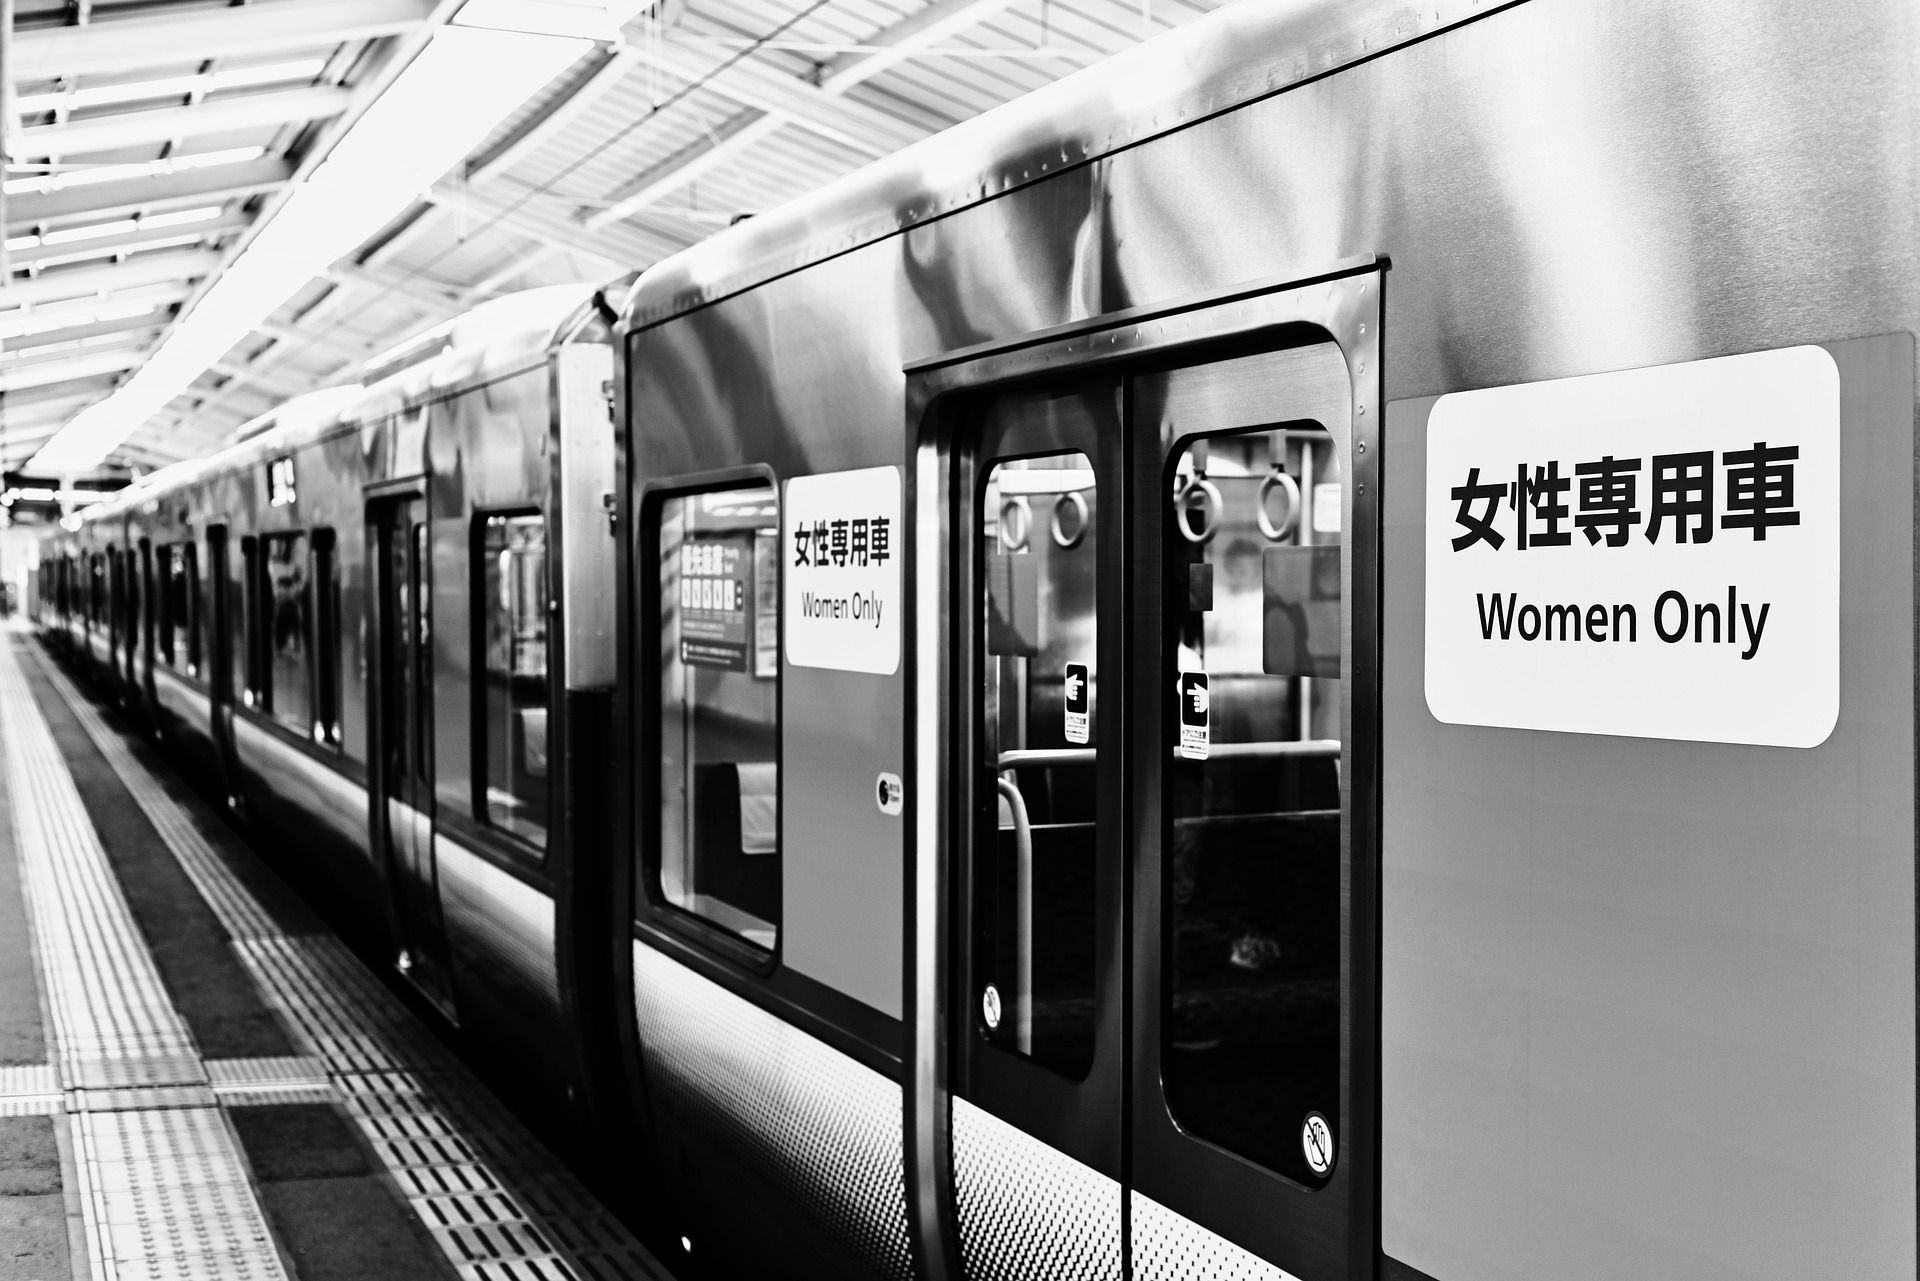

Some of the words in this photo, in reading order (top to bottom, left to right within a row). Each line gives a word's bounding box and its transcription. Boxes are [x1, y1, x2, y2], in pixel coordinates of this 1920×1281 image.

[1450, 441, 1801, 553] 女性専用車
[794, 515, 890, 568] 女性専用車
[802, 592, 848, 619] Women
[852, 590, 883, 629] Only
[1476, 592, 1637, 643] Women
[1653, 585, 1771, 661] Only
